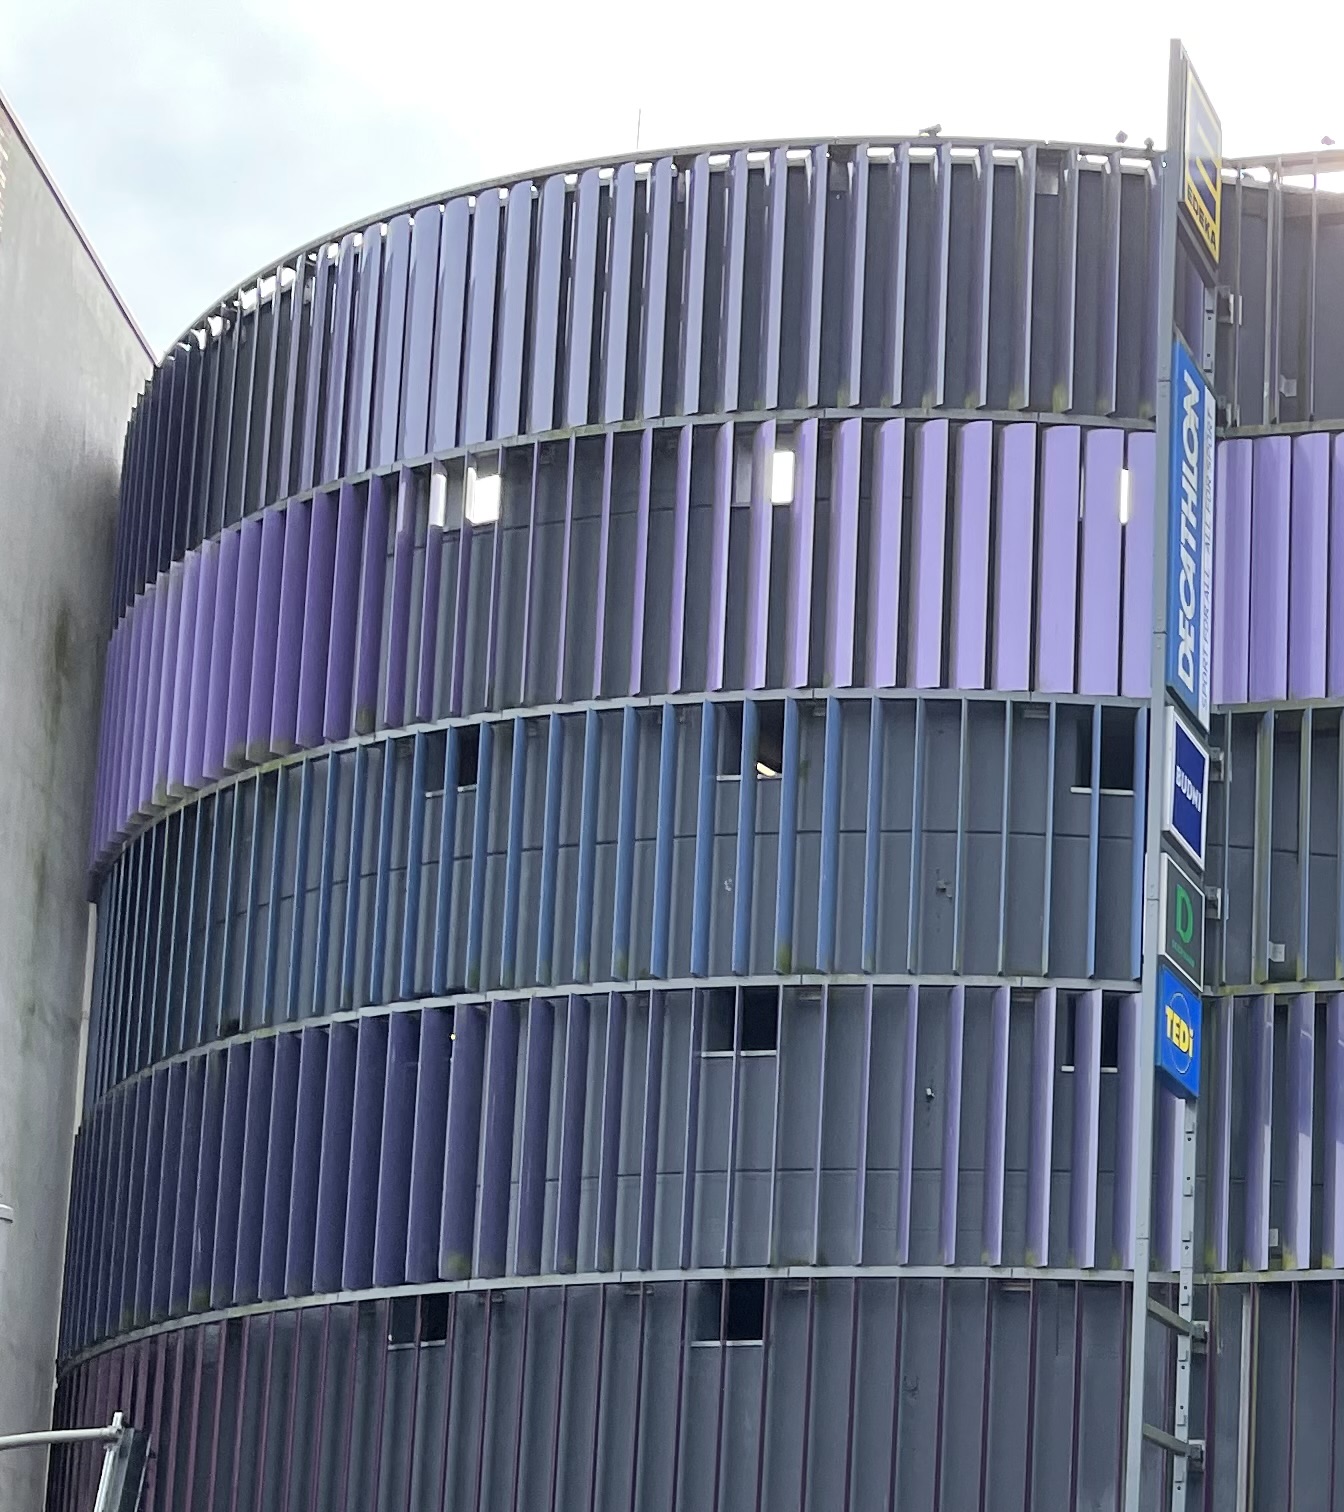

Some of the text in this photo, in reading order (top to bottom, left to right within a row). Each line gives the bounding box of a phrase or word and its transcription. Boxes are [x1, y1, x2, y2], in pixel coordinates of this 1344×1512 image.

[1187, 184, 1217, 250] EDEKA
[1178, 369, 1200, 693] DECATHLON
[1165, 1004, 1194, 1058] TEDi
